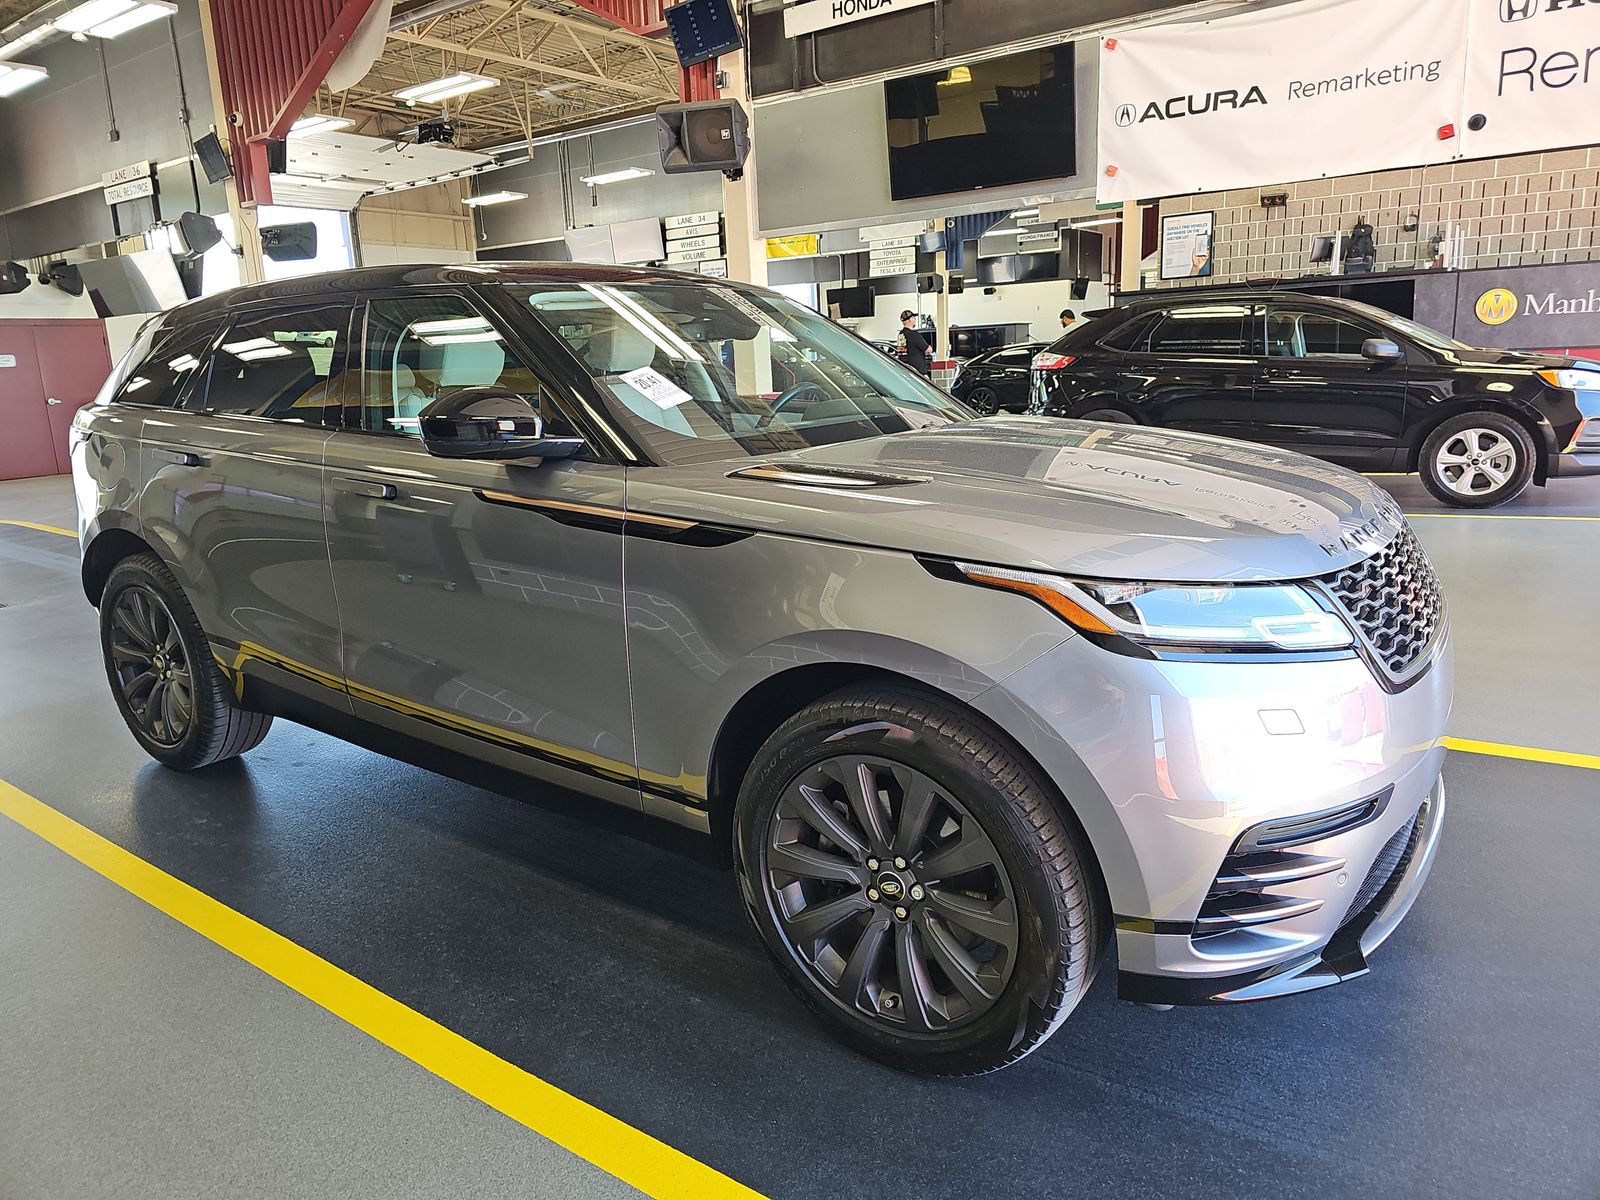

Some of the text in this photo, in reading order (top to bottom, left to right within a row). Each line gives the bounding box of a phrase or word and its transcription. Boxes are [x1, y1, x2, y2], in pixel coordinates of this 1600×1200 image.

[1138, 59, 1442, 123] ACURA Remarketing
[111, 165, 141, 183] LANE 36
[677, 216, 693, 225] LANE
[685, 227, 699, 236] AVIS
[680, 239, 706, 249] WHEELS
[681, 251, 706, 260] VOLUME
[876, 258, 908, 266] ENTERPRISE
